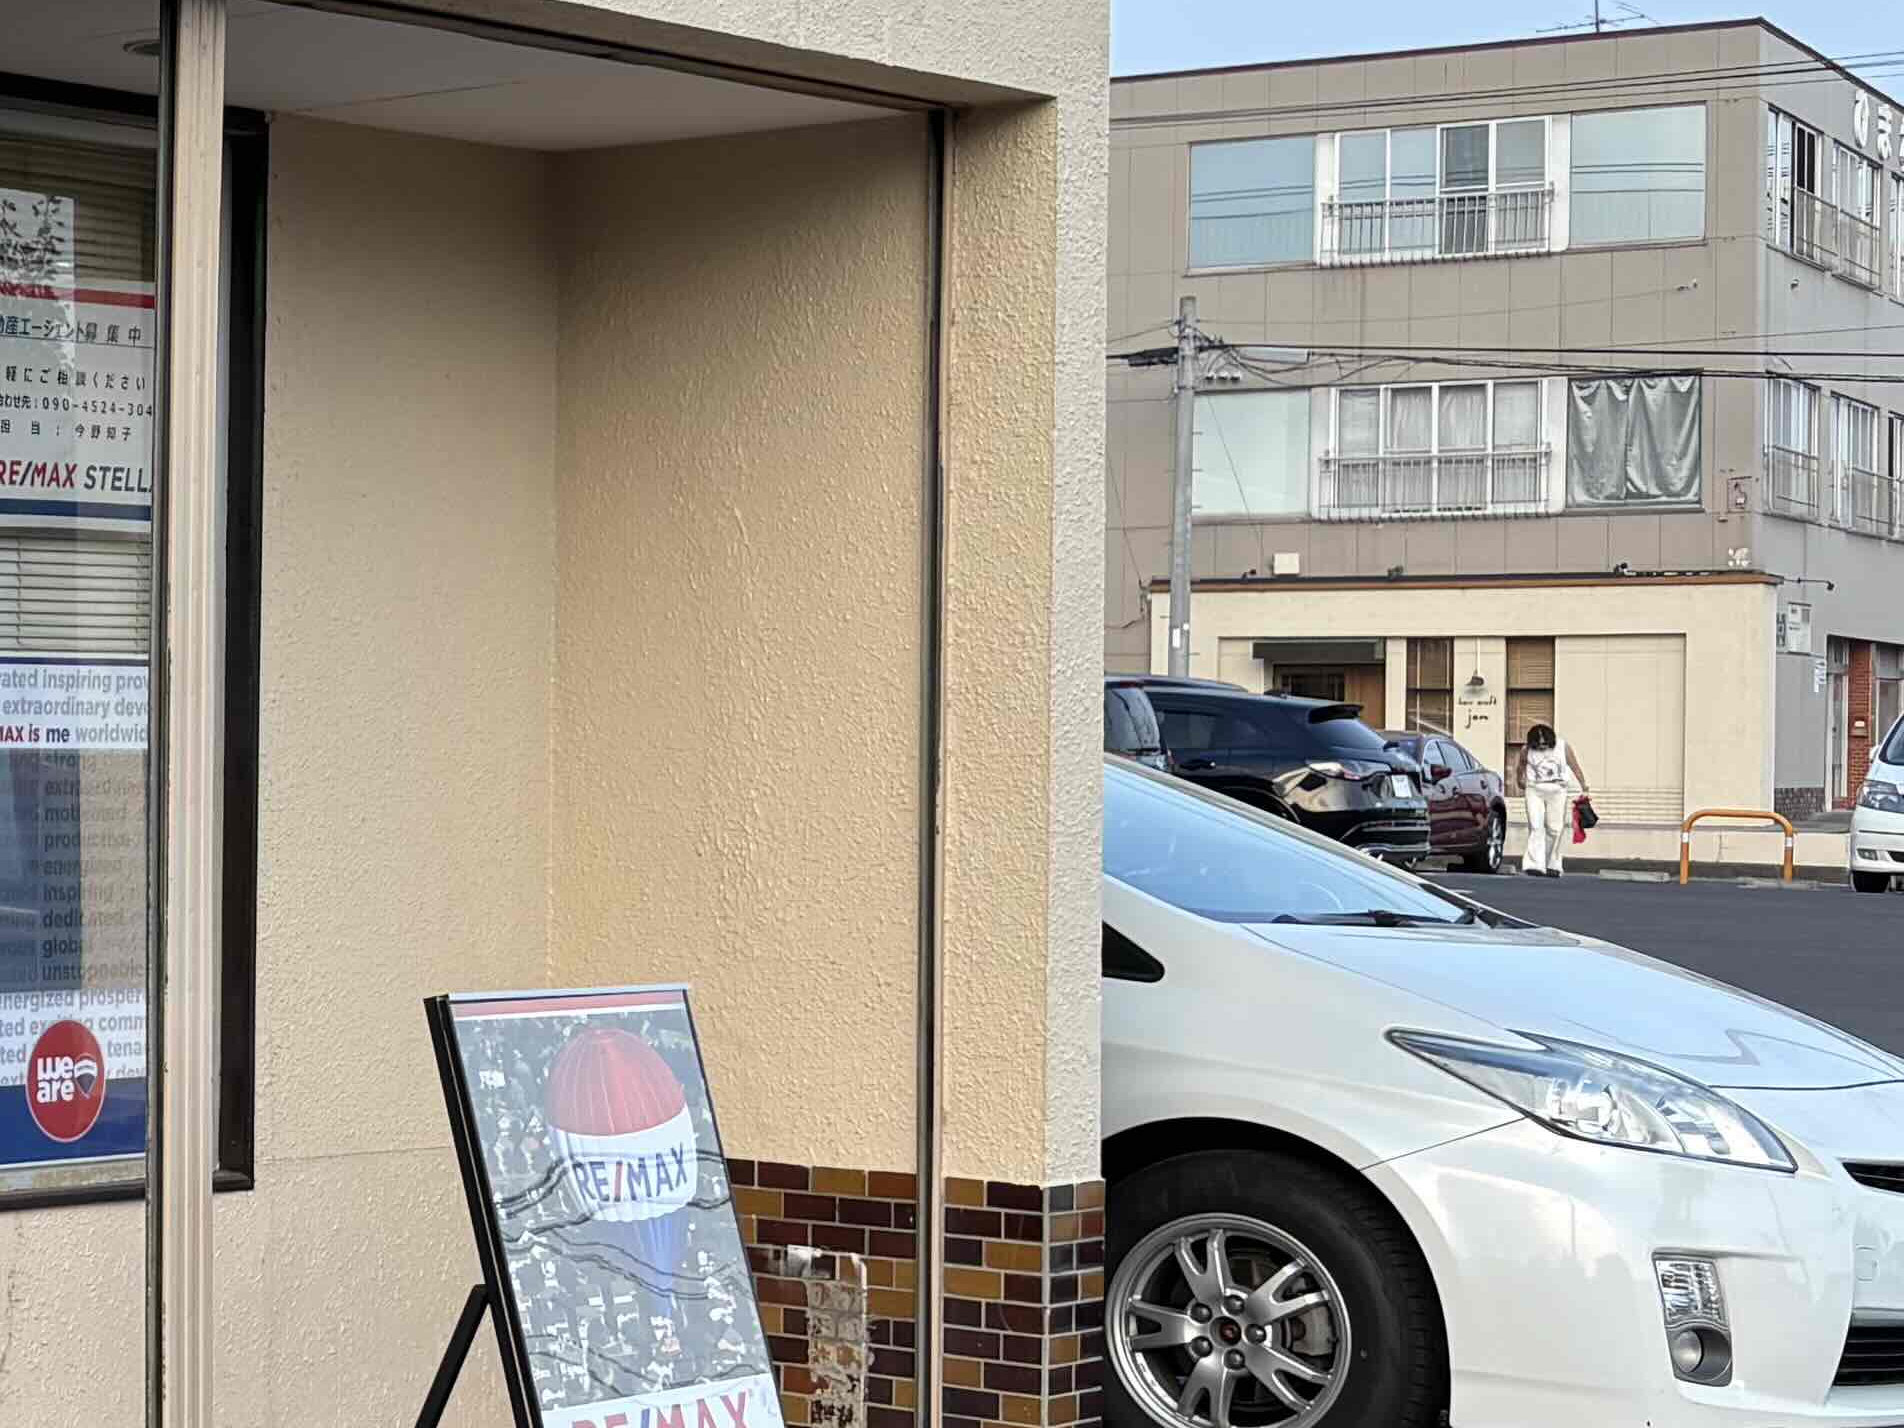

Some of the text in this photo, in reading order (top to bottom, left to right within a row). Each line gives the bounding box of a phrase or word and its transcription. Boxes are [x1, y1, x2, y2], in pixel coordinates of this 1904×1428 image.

[84, 465, 152, 493] STELL
[42, 669, 111, 692] inspiring
[3, 697, 111, 718] extraordinary
[28, 723, 40, 742] is
[46, 727, 70, 742] me
[36, 1055, 74, 1080] we
[36, 1080, 75, 1104] are
[573, 1142, 689, 1203] RE/MAX
